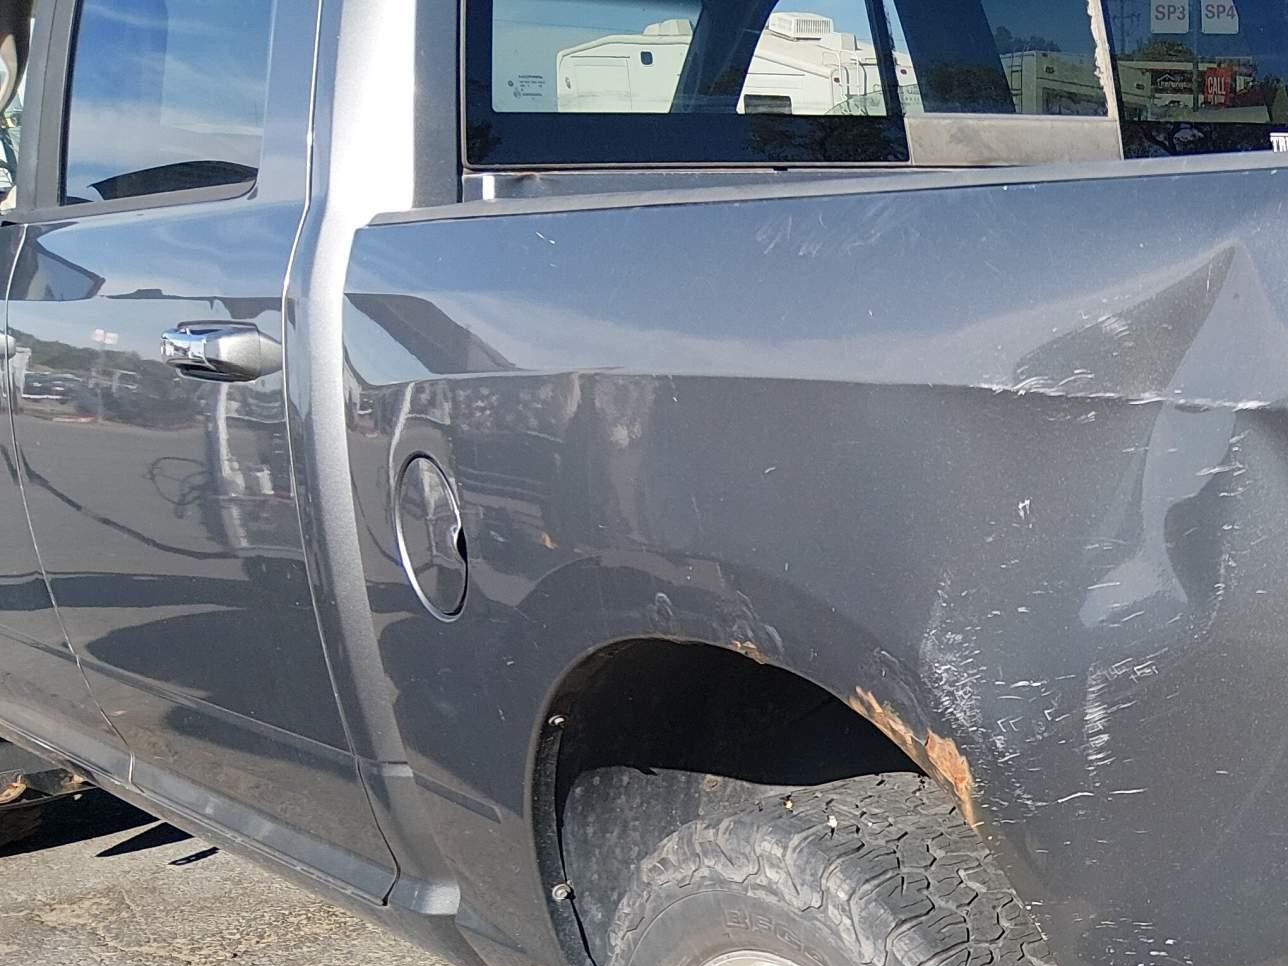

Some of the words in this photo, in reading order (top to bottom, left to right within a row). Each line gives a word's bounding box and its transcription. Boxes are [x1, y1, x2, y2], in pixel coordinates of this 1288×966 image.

[1154, 3, 1187, 21] SP3
[1204, 3, 1237, 20] SP4
[1207, 76, 1226, 95] CALL
